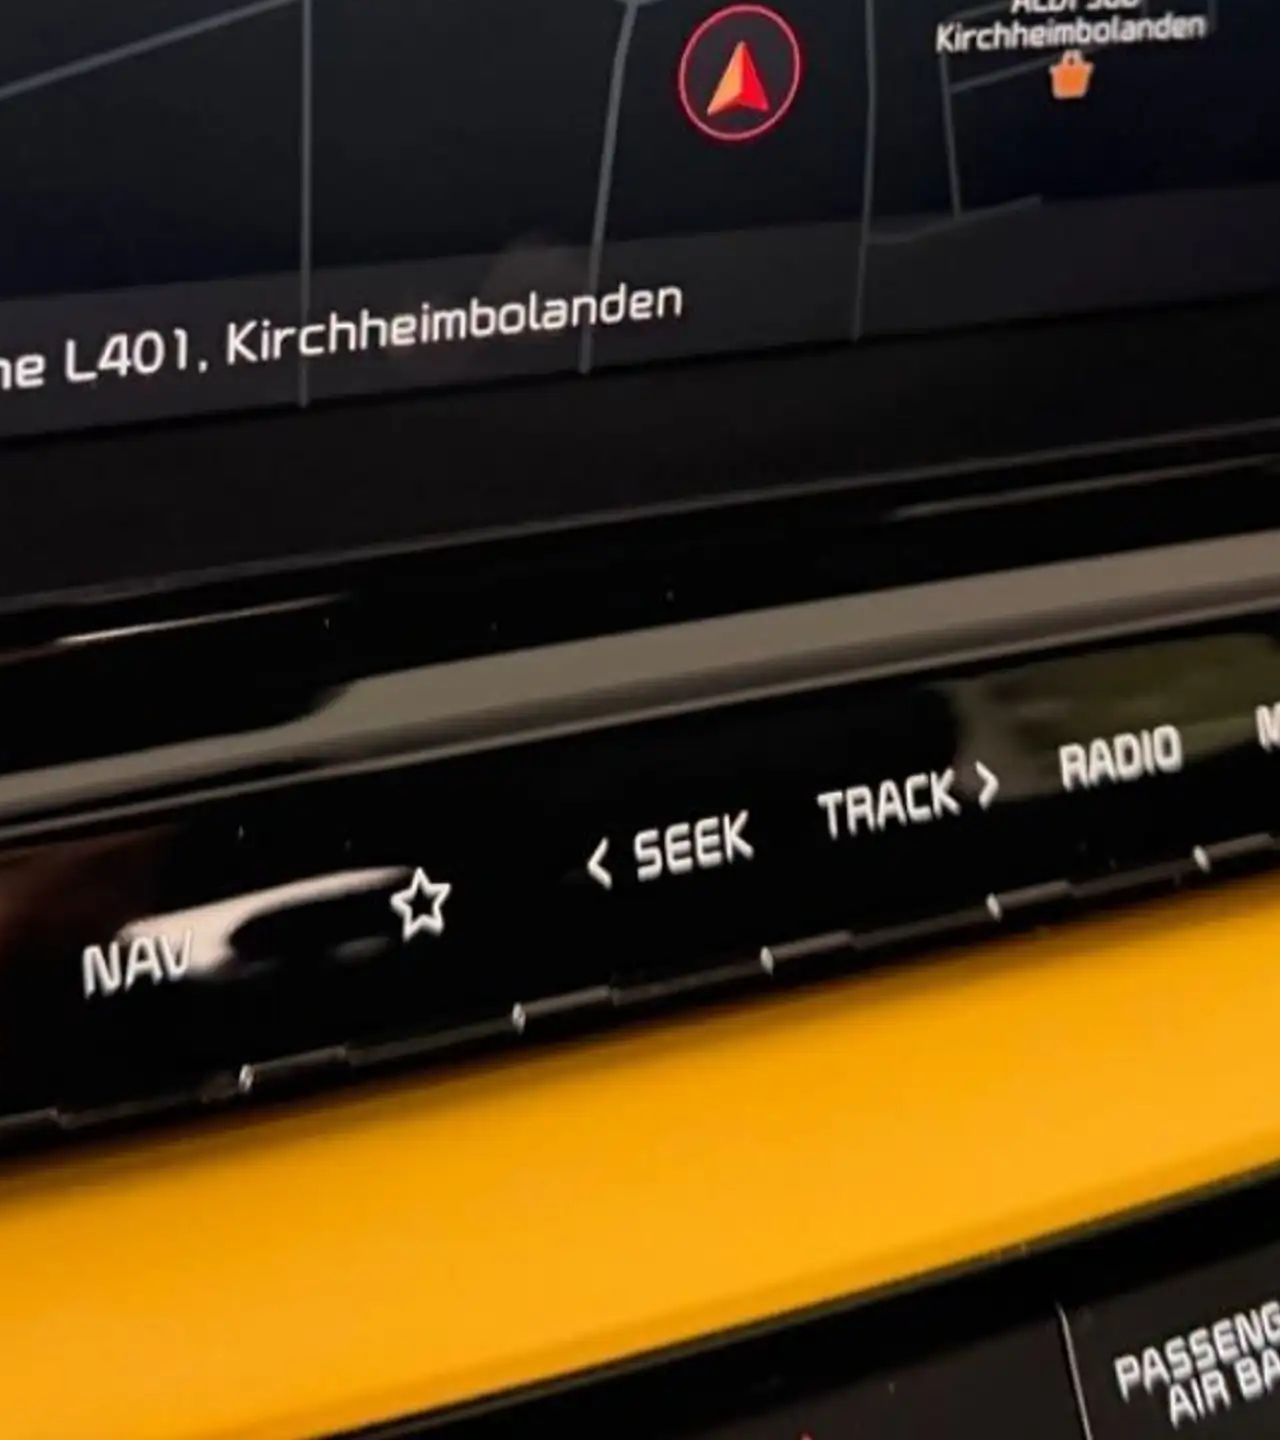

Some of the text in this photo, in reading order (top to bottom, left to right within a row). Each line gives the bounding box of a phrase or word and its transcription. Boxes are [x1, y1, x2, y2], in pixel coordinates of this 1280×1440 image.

[935, 14, 1208, 54] Kirchheimbolanden
[64, 330, 209, 381] L401,
[226, 282, 686, 366] Kirchheimbolanden
[1058, 724, 1183, 793] RADIO
[816, 767, 962, 841] TRACK
[634, 809, 754, 883] SEEK
[82, 928, 194, 1000] NAV
[1168, 1367, 1232, 1430] AIR
